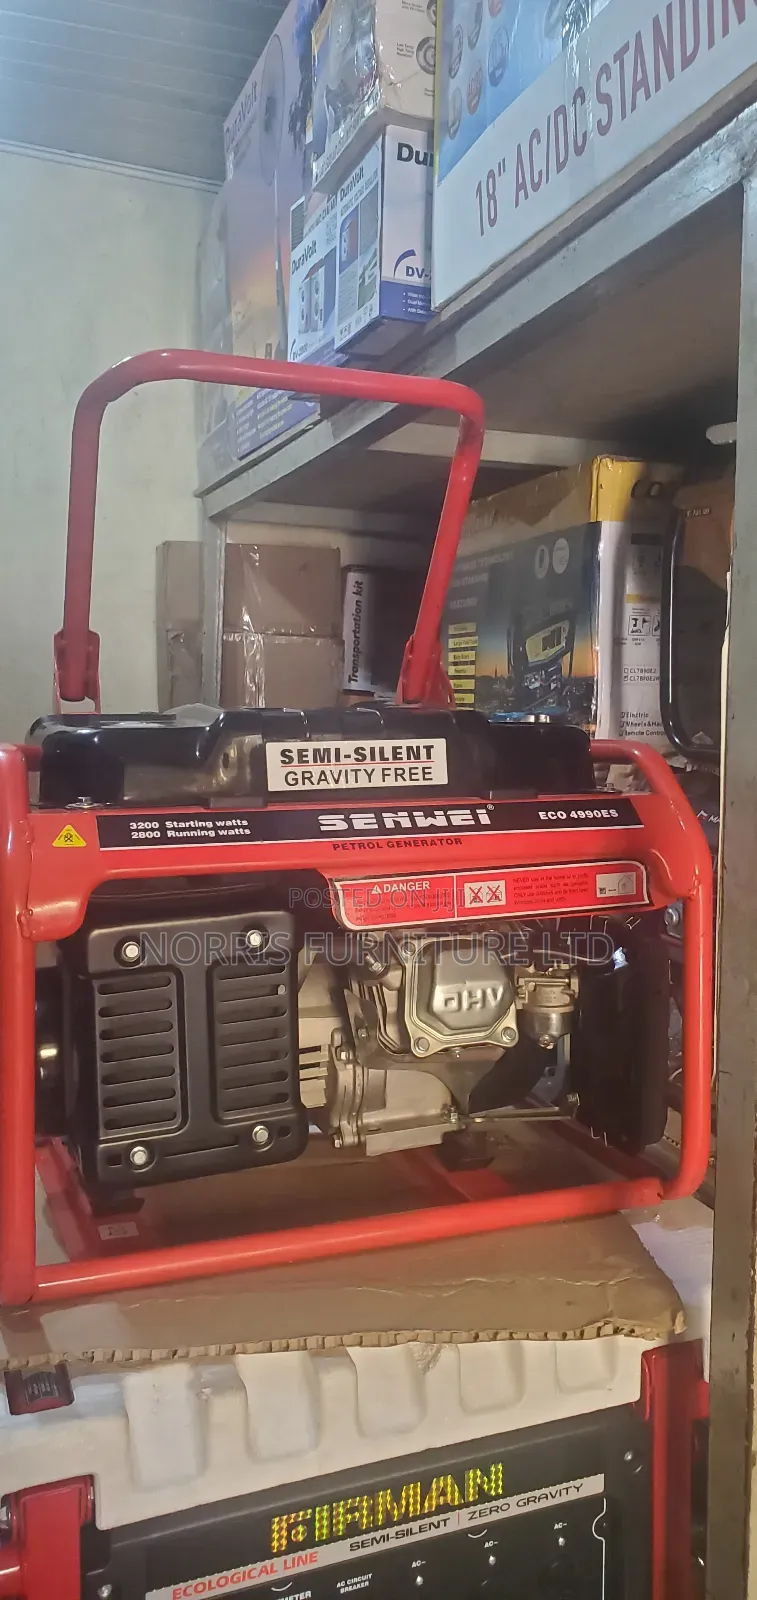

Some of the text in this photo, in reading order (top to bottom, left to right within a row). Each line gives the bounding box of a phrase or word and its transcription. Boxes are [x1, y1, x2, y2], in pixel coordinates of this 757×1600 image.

[514, 86, 588, 209] AC/DC
[405, 265, 431, 279] DV-
[347, 580, 364, 684] Transportation kit
[280, 745, 434, 765] SEMI-SILENT
[284, 767, 433, 787] GRAVITY FREE
[538, 809, 619, 820] ECO 4990ES
[165, 820, 213, 828] Starting
[215, 819, 249, 827] watts
[131, 831, 161, 839] 2800
[167, 829, 215, 837] Running
[333, 838, 463, 851] PETROL GENERATOR
[383, 881, 430, 893] DANGER
[434, 985, 504, 1012] OHV
[271, 1462, 504, 1553] FIRMAN
[349, 1483, 584, 1551] SEMI-SILENT ZERO GRAVITY
[172, 1552, 318, 1600] ECOLOGICAL LINE
[346, 1574, 373, 1585] CIRCUIT
[340, 1581, 370, 1594] BREAKER
